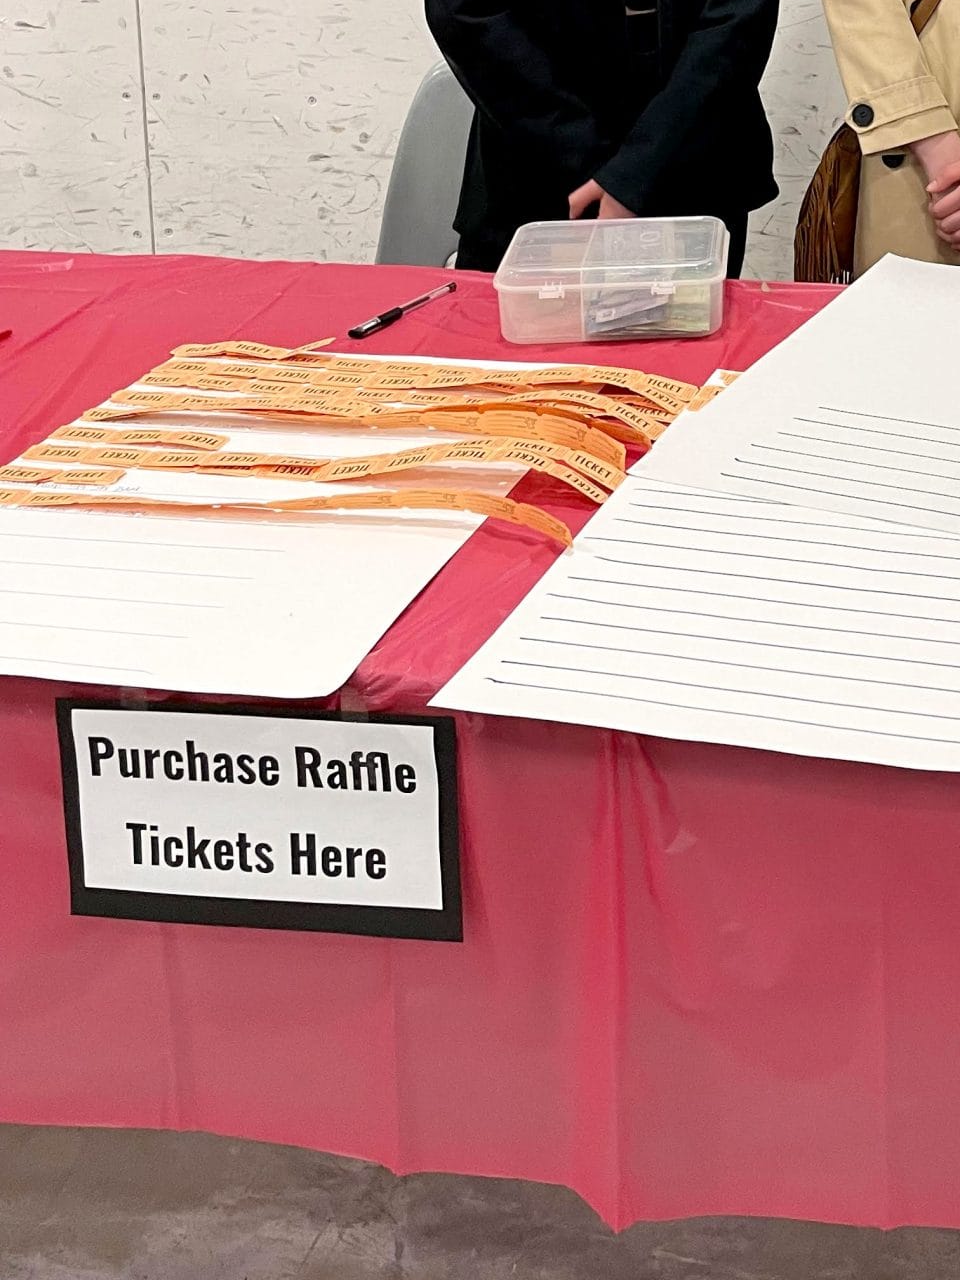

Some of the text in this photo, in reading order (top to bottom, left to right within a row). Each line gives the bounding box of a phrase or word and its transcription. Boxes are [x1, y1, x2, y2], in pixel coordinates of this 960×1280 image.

[250, 383, 286, 391] TICKET
[647, 378, 683, 393] TICKET
[560, 392, 596, 401] TICKET
[644, 388, 680, 408] TICKET
[614, 406, 650, 428] TICKET
[66, 430, 106, 439] TICKET
[180, 434, 218, 445] TICKET
[514, 441, 553, 453] TICKET
[100, 451, 140, 460] TICKET
[388, 454, 427, 467] TICKET
[505, 451, 546, 467] TICKET
[272, 465, 316, 476] TICKET
[332, 464, 371, 475] TICKET
[574, 455, 612, 479] TICKET
[565, 473, 601, 498] TICKET
[88, 736, 417, 794] Purchase Raffle
[126, 822, 387, 880] Tickets Here
